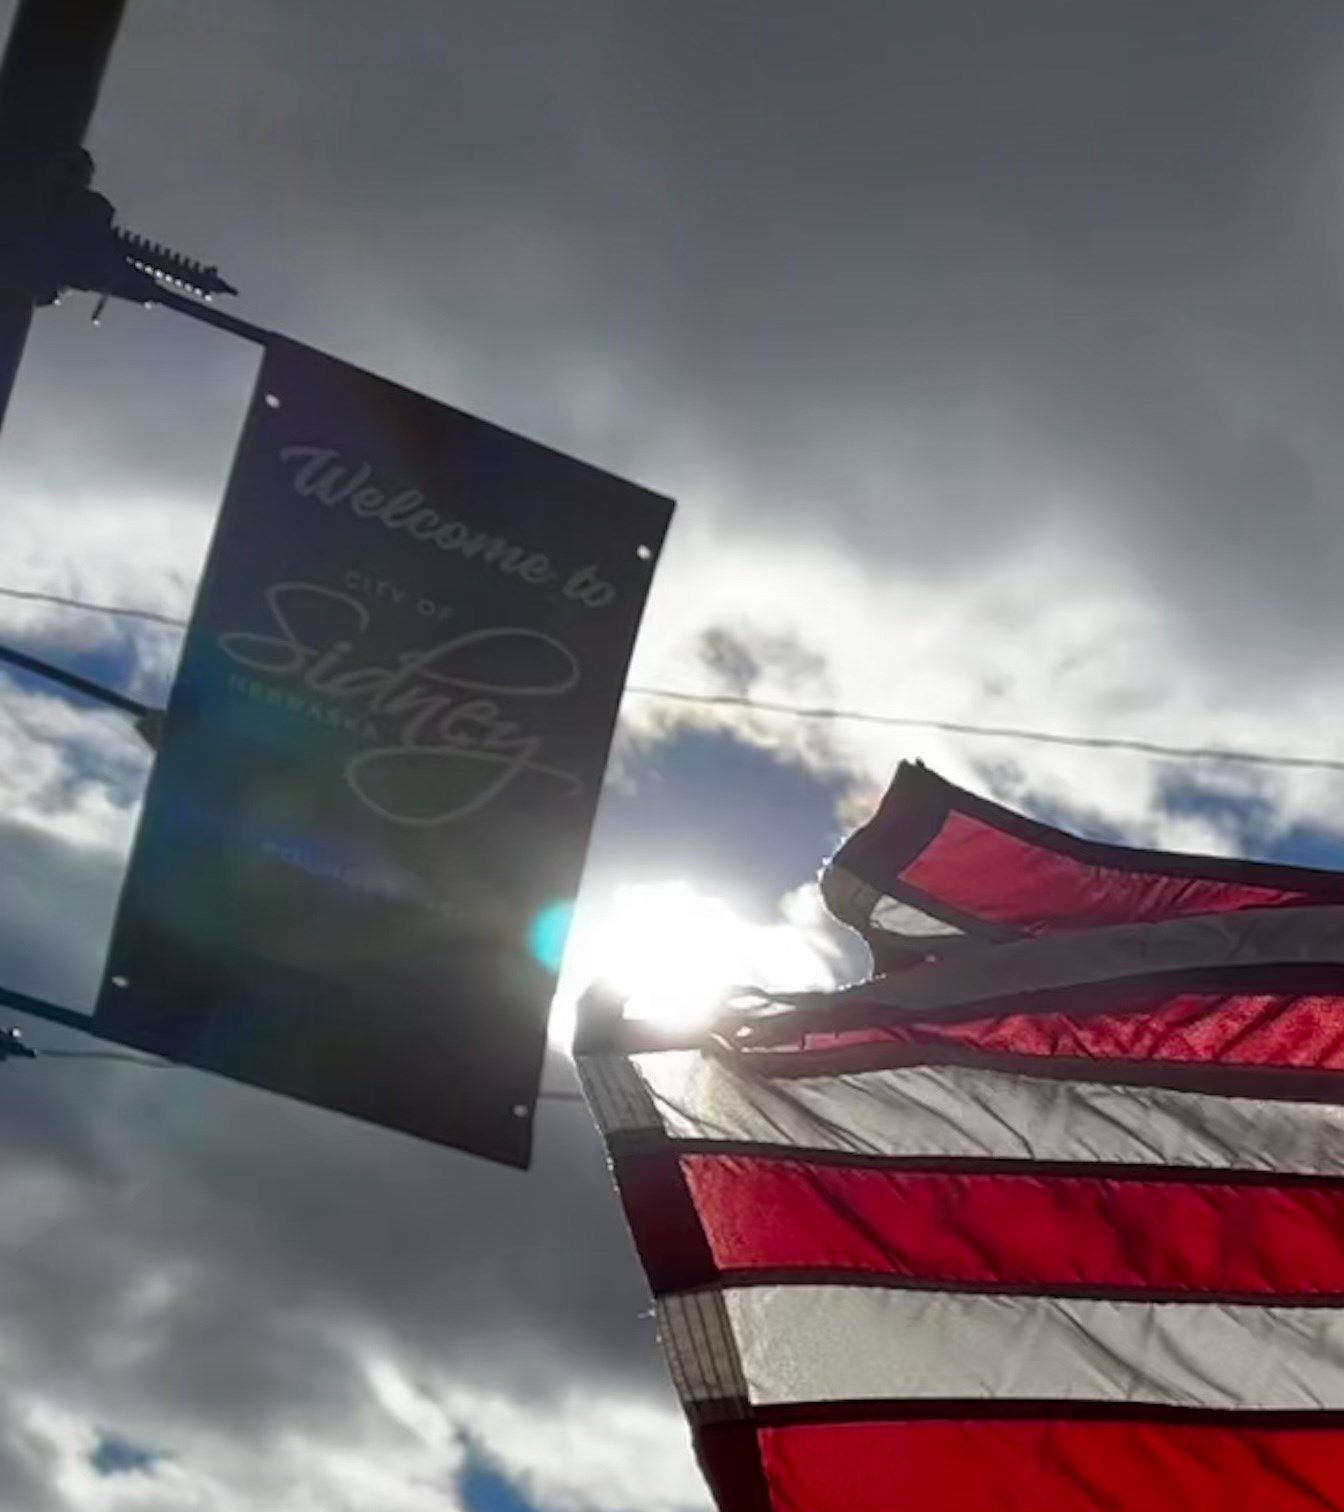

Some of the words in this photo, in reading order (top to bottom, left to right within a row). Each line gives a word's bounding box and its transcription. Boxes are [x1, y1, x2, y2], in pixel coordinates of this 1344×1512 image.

[278, 445, 556, 583] Welcome
[561, 563, 616, 609] to
[344, 569, 408, 604] CITY
[417, 597, 457, 623] OF
[217, 580, 584, 827] Sidney
